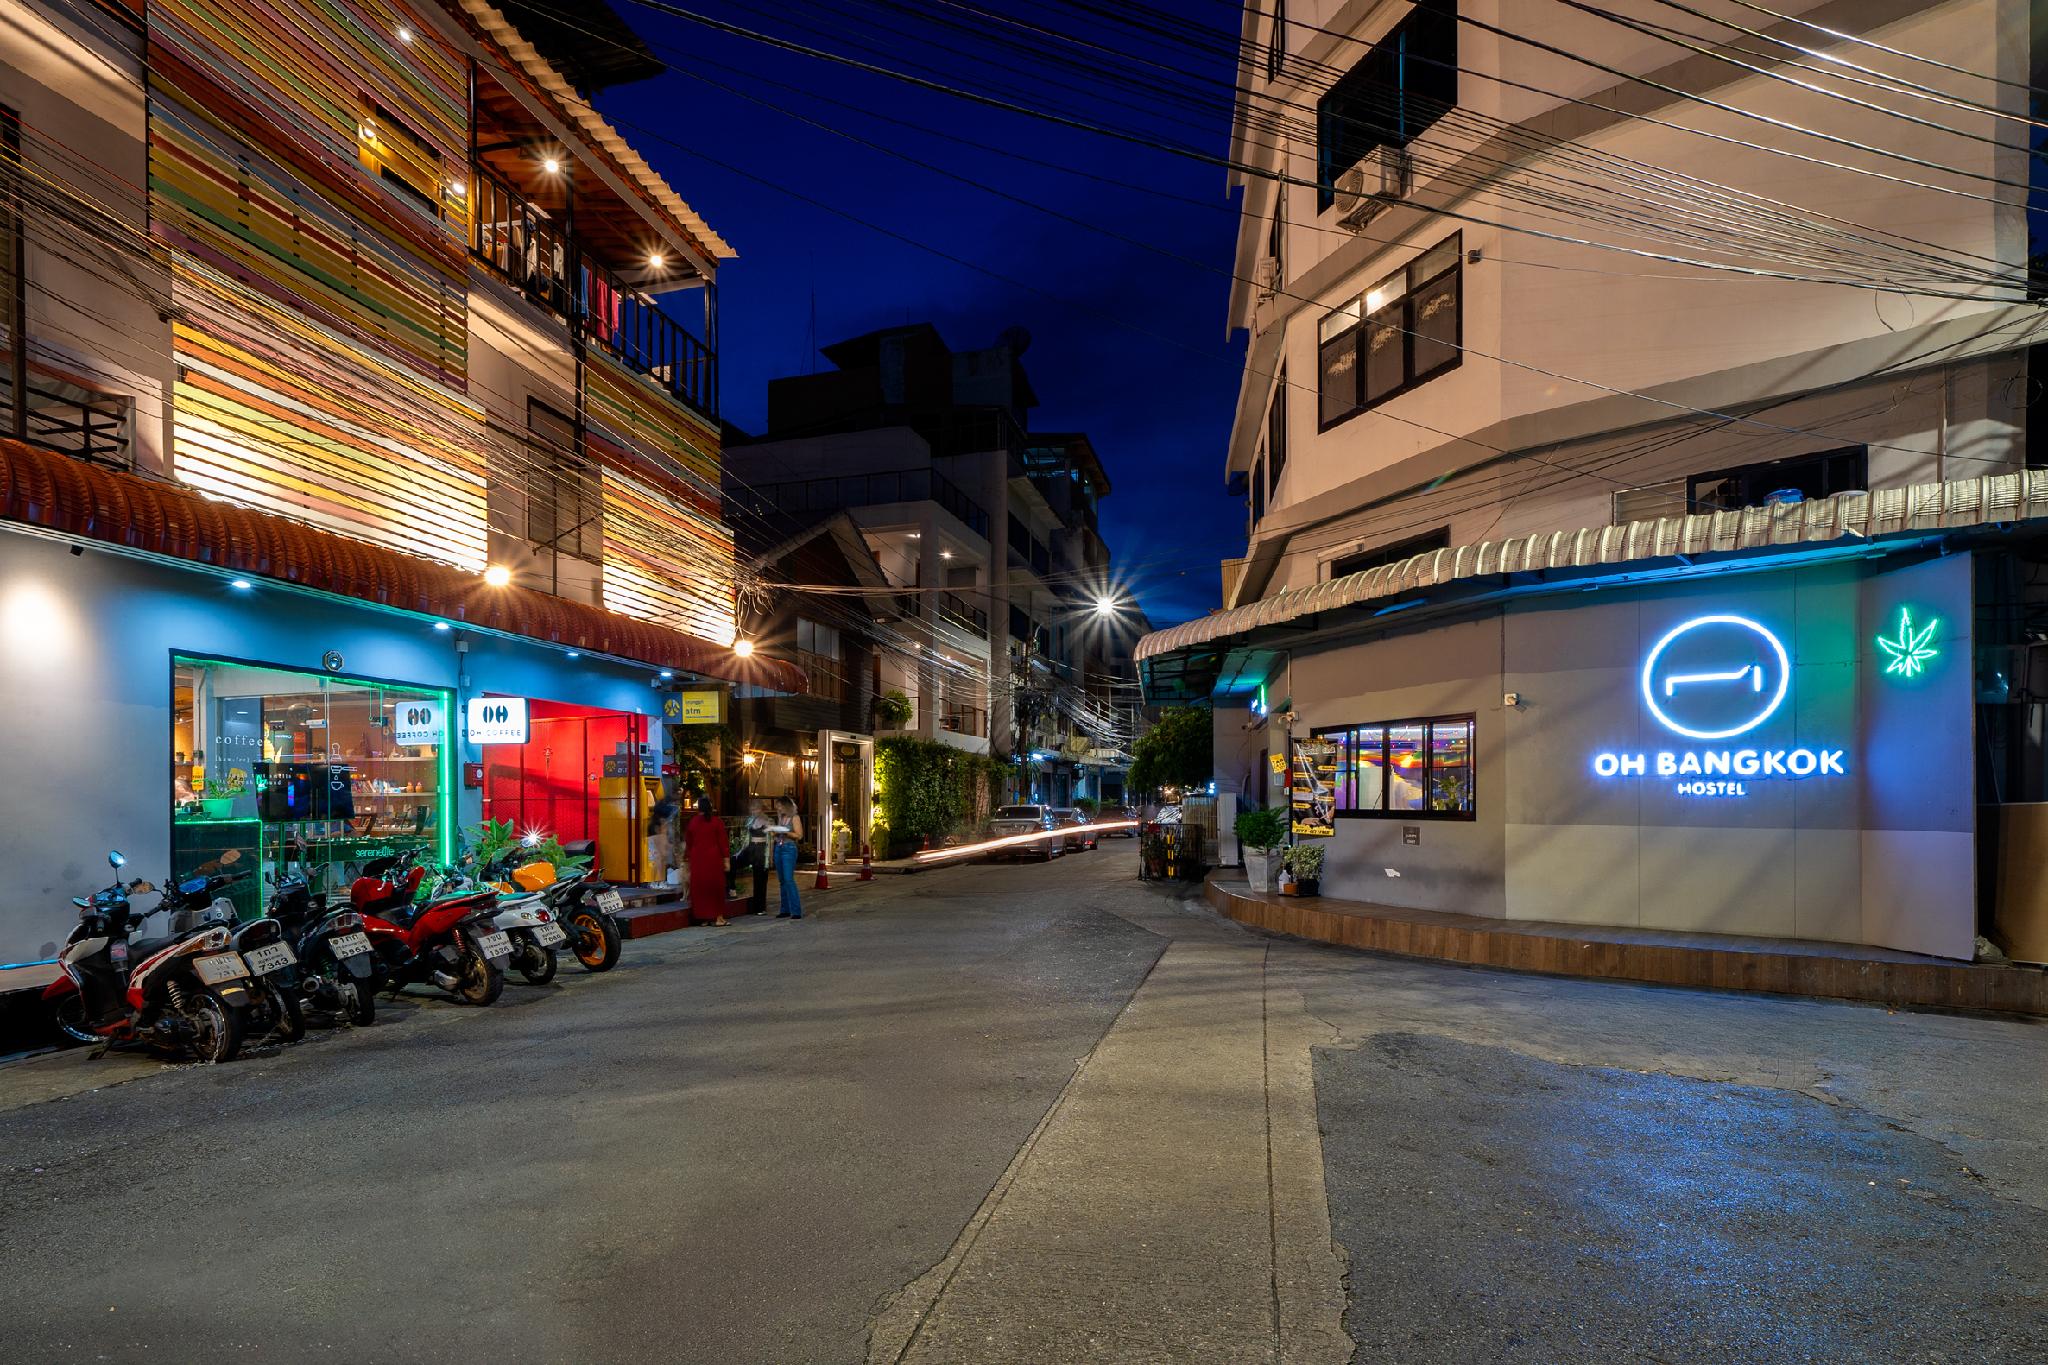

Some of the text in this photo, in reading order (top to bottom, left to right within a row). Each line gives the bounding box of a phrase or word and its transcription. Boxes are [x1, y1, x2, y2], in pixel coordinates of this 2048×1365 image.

[487, 729, 521, 737] COFFEE
[215, 734, 263, 747] coffee
[1594, 748, 1844, 776] OH BANGKOK
[1677, 782, 1745, 796] HOSTEL
[259, 957, 289, 971] 7343
